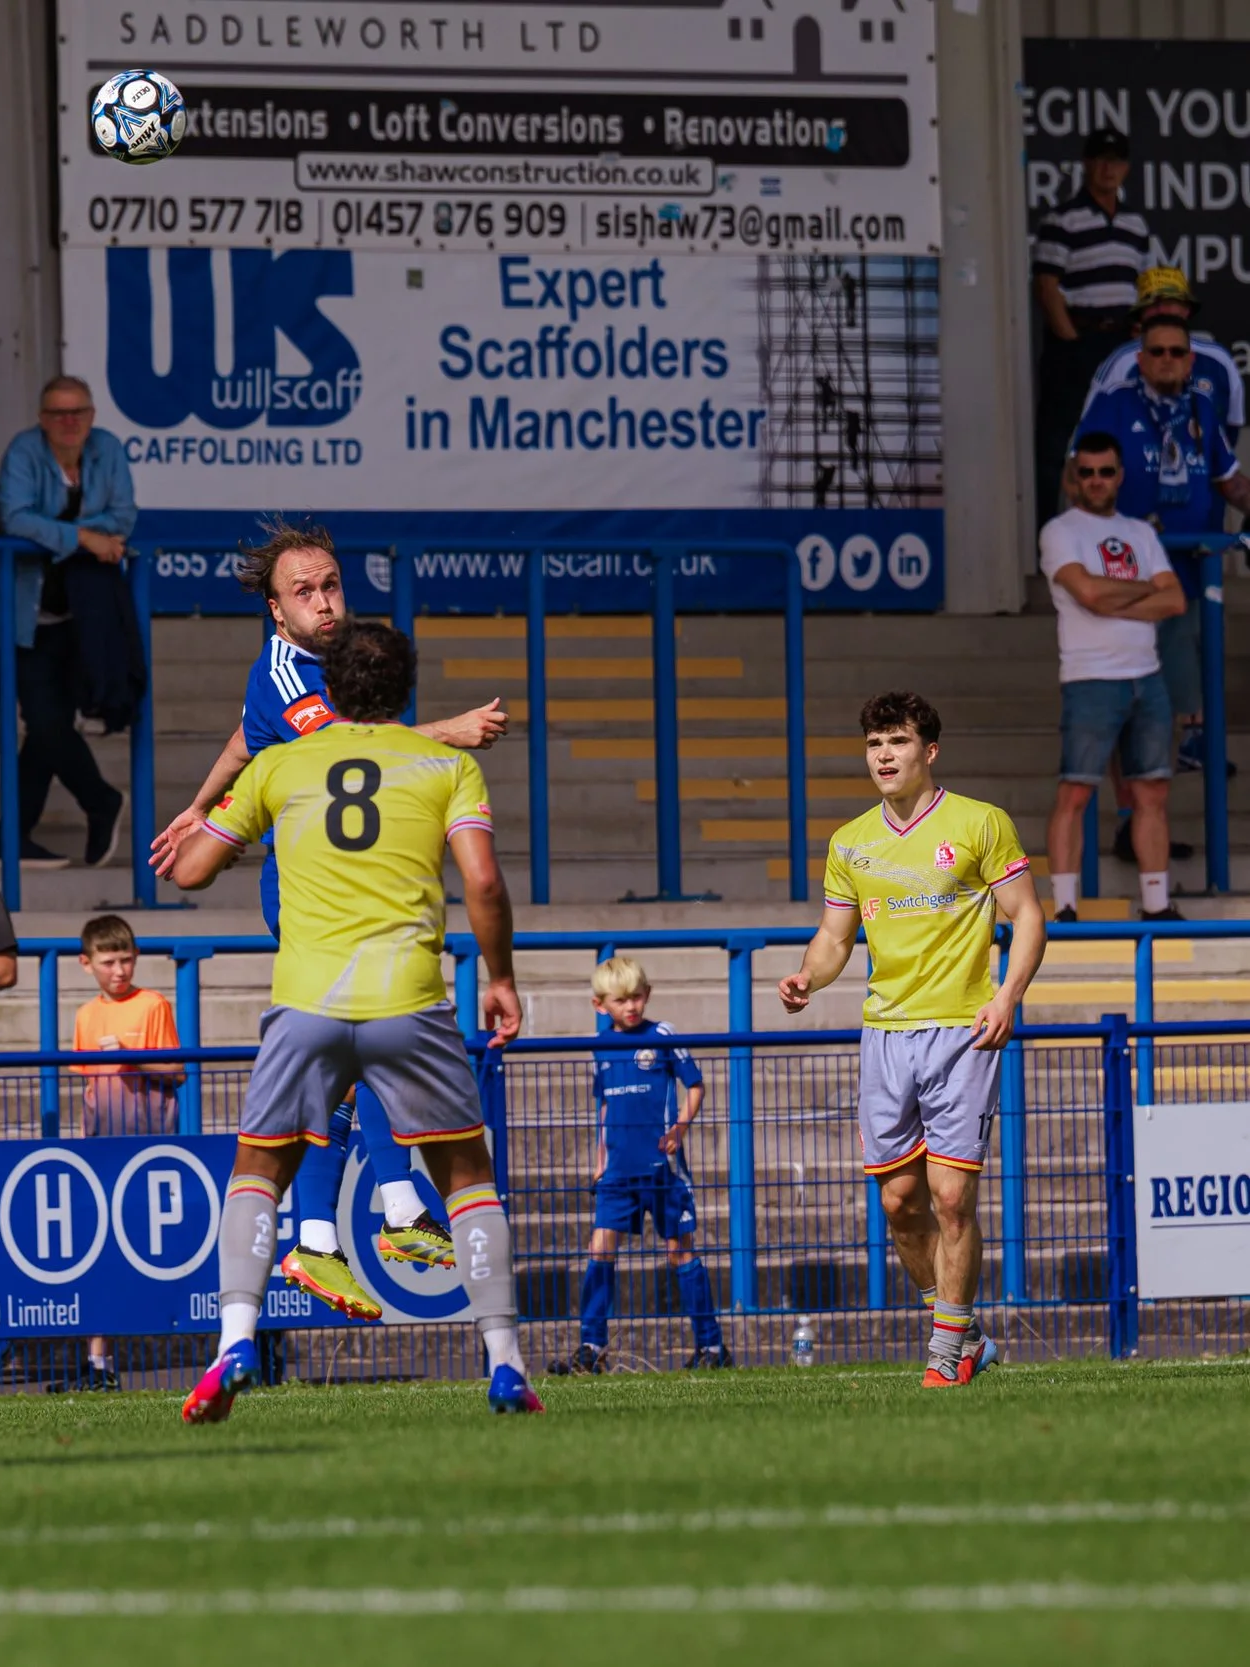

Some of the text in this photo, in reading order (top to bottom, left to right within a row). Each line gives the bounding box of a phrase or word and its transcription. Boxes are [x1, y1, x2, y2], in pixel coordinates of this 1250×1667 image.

[120, 13, 601, 54] SADDLEWORTH LTD
[186, 101, 848, 148] xtensions Loft Conversions Renovations
[306, 158, 701, 187] www.shawconstruction.co.uk
[88, 196, 906, 247] 07710 577 718 01457 876 909 sishaw73@gmail.com
[499, 255, 667, 322] Expert
[438, 324, 729, 380] Scaffolders
[211, 367, 363, 412] willscaff
[406, 396, 767, 450] in Manchester
[313, 439, 363, 466] LTD
[325, 757, 382, 852] 8
[886, 891, 960, 910] Switchgear
[34, 1173, 73, 1261] H
[146, 1168, 184, 1257] P
[6, 1292, 80, 1328] Limited
[190, 1291, 222, 1321] 016
[267, 1289, 313, 1318] 0999
